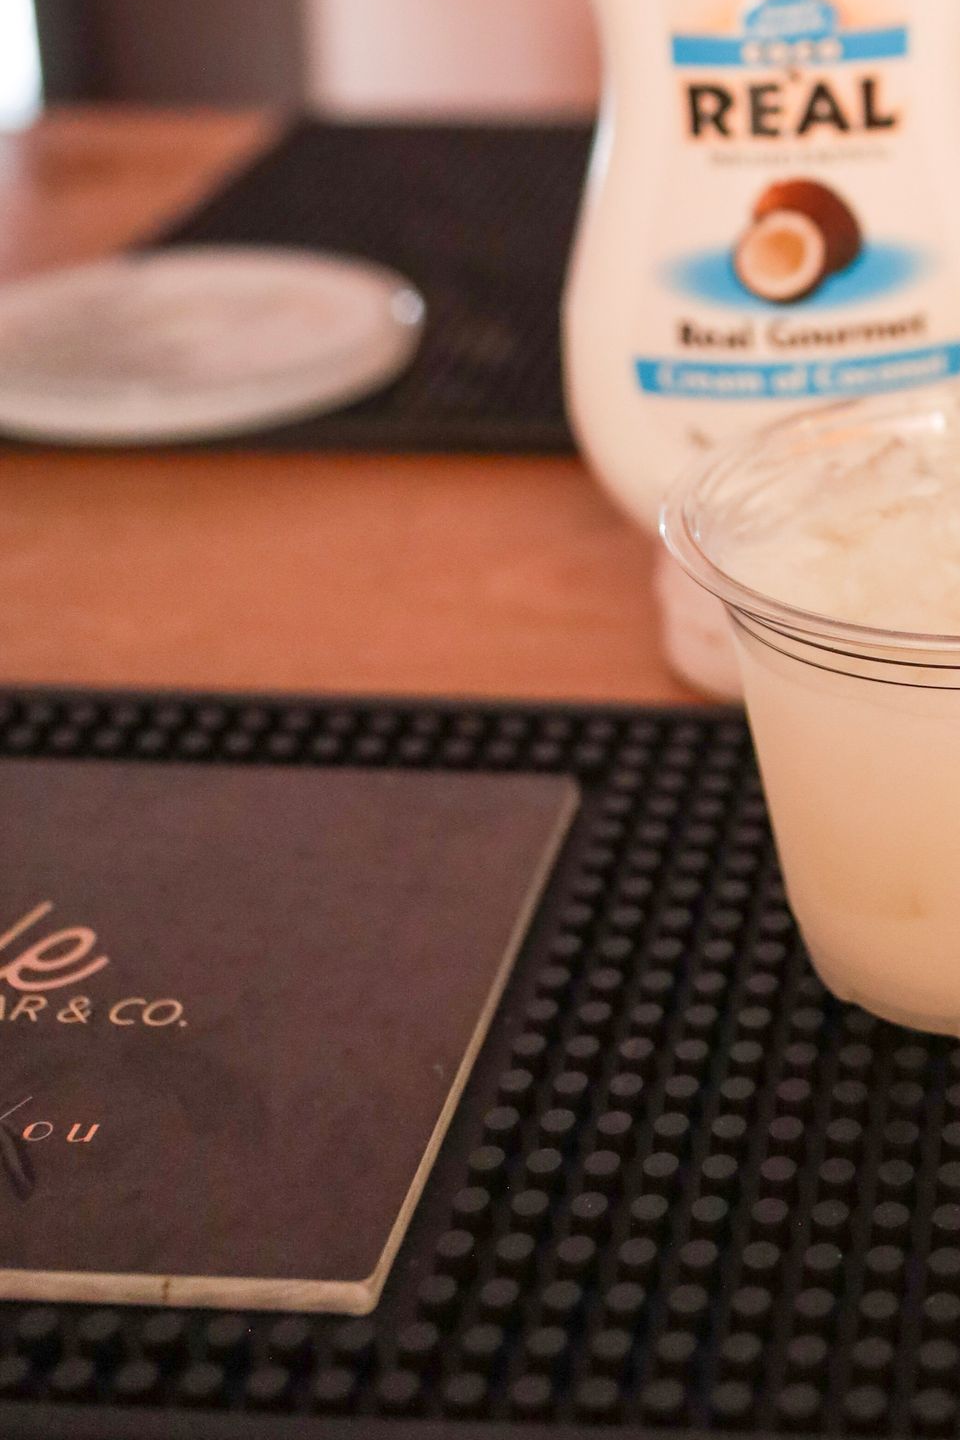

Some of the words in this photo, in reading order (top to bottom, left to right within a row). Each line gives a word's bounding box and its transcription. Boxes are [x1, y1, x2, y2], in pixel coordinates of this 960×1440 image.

[688, 77, 897, 137] REAL
[677, 317, 754, 349] Real
[767, 313, 927, 350] Gourmet
[57, 996, 91, 1023] &
[109, 998, 188, 1027] CO.
